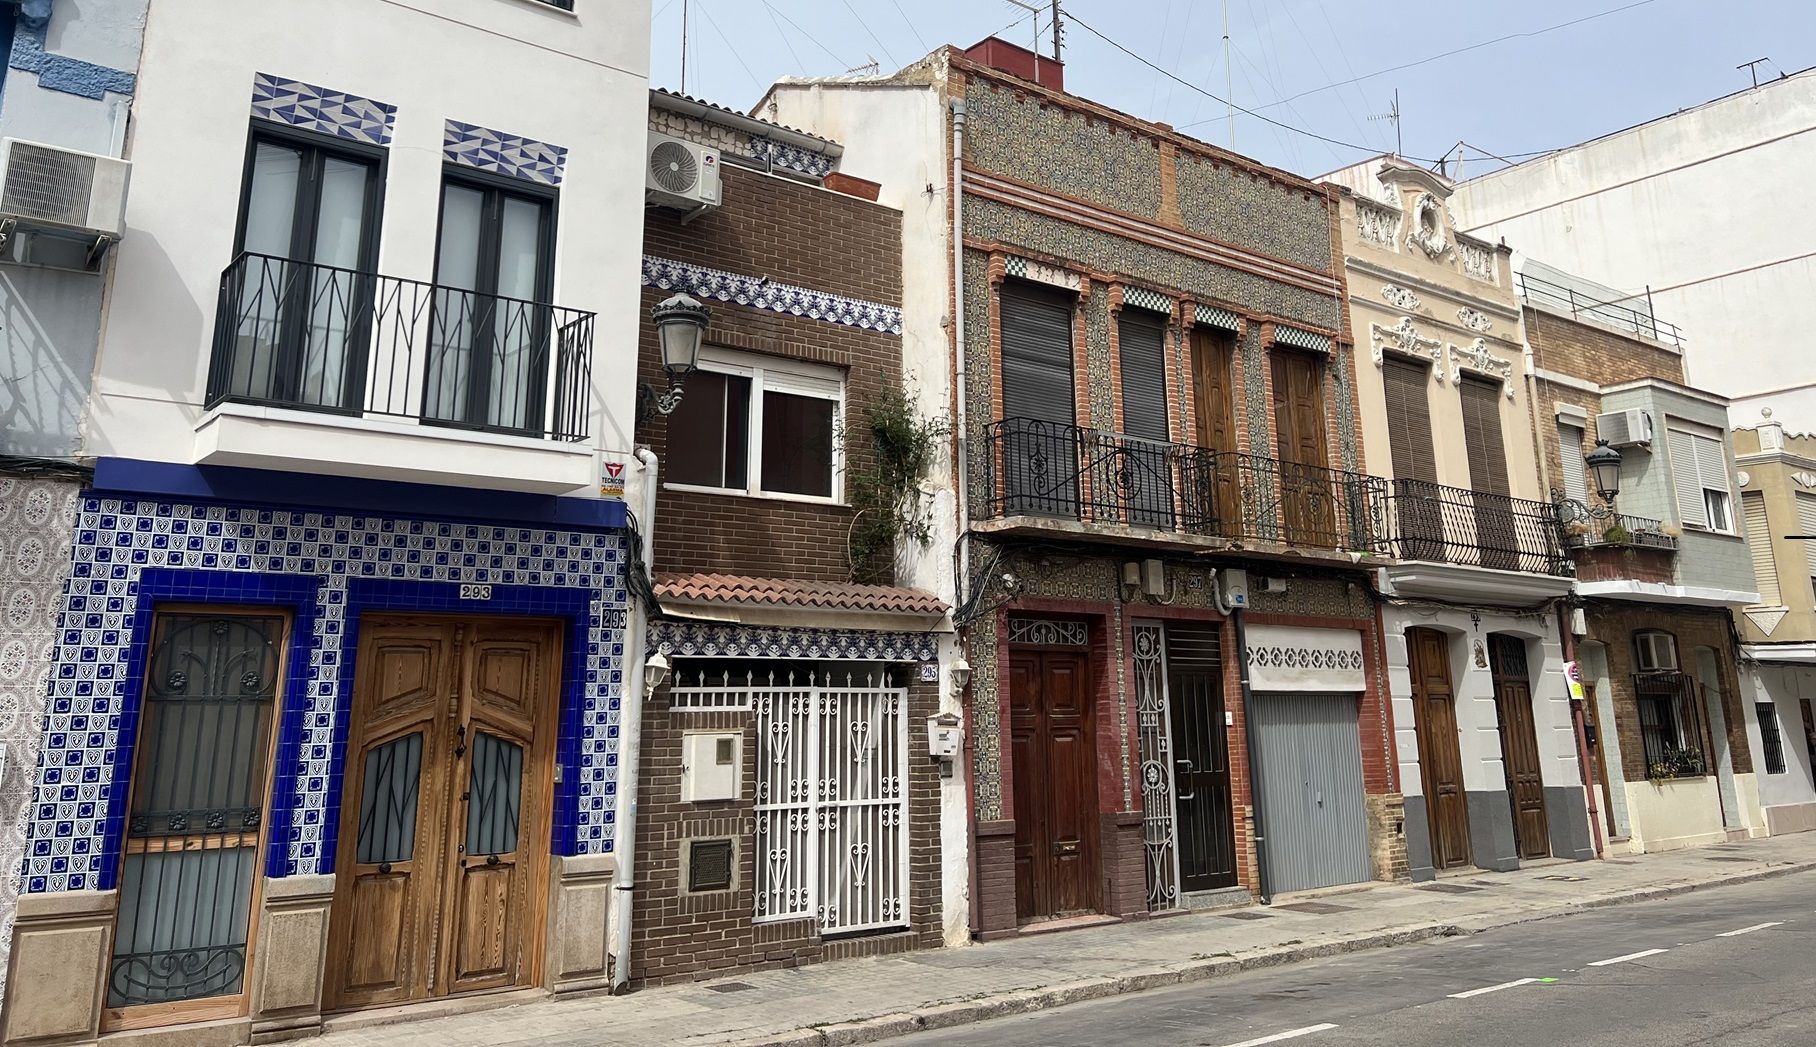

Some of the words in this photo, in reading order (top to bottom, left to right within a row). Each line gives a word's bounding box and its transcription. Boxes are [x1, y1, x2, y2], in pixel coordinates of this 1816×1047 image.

[1189, 575, 1202, 588] 297
[462, 586, 491, 598] 293
[604, 610, 626, 627] 293
[923, 667, 936, 678] 295
